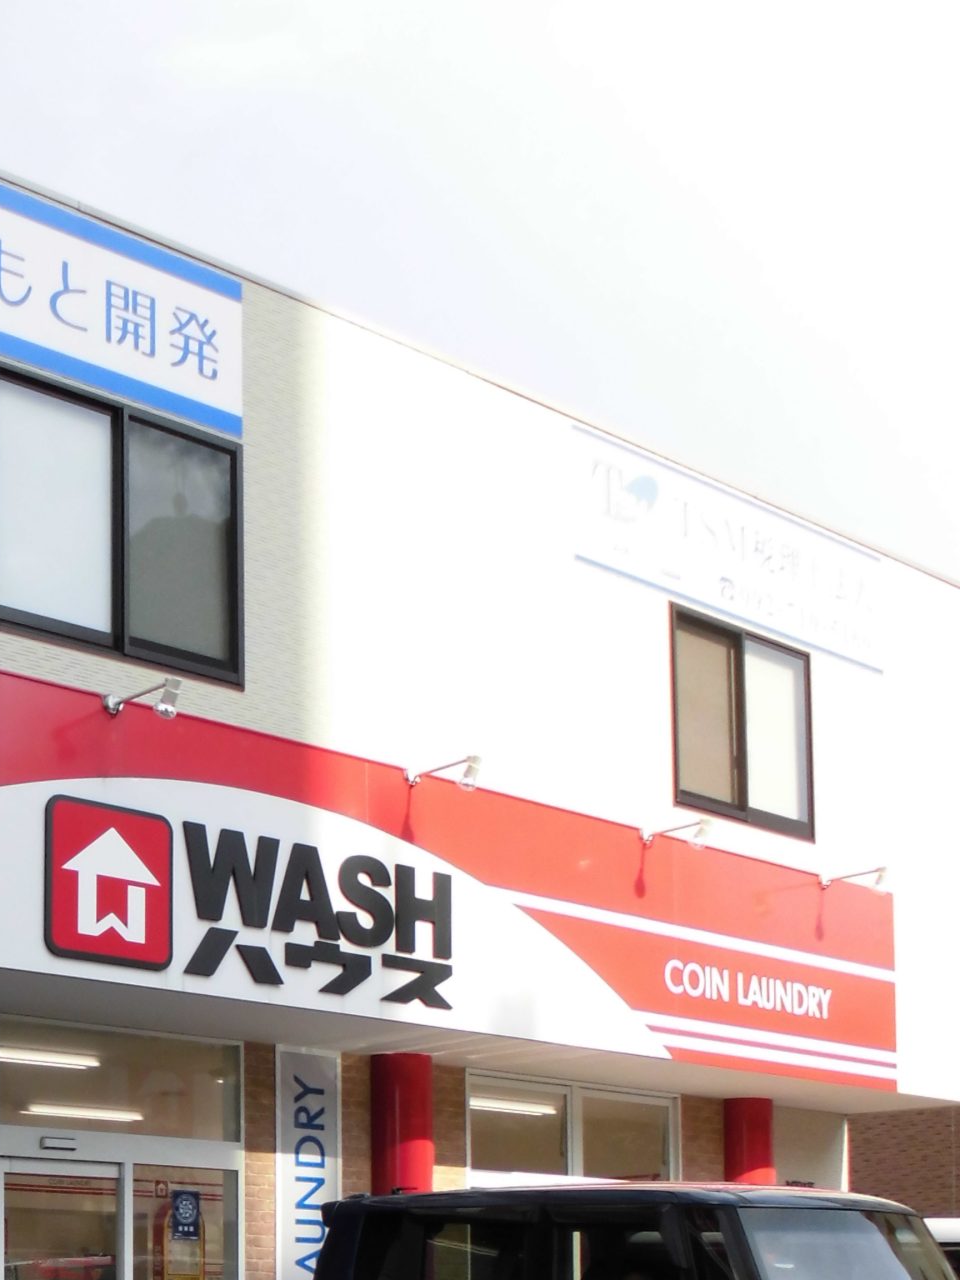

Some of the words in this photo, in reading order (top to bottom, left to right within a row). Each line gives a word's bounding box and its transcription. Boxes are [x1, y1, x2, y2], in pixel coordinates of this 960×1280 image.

[183, 821, 452, 960] WASH
[183, 926, 453, 1010] ハウス
[664, 959, 730, 1002] COIN
[737, 972, 832, 1019] LAUNDRY
